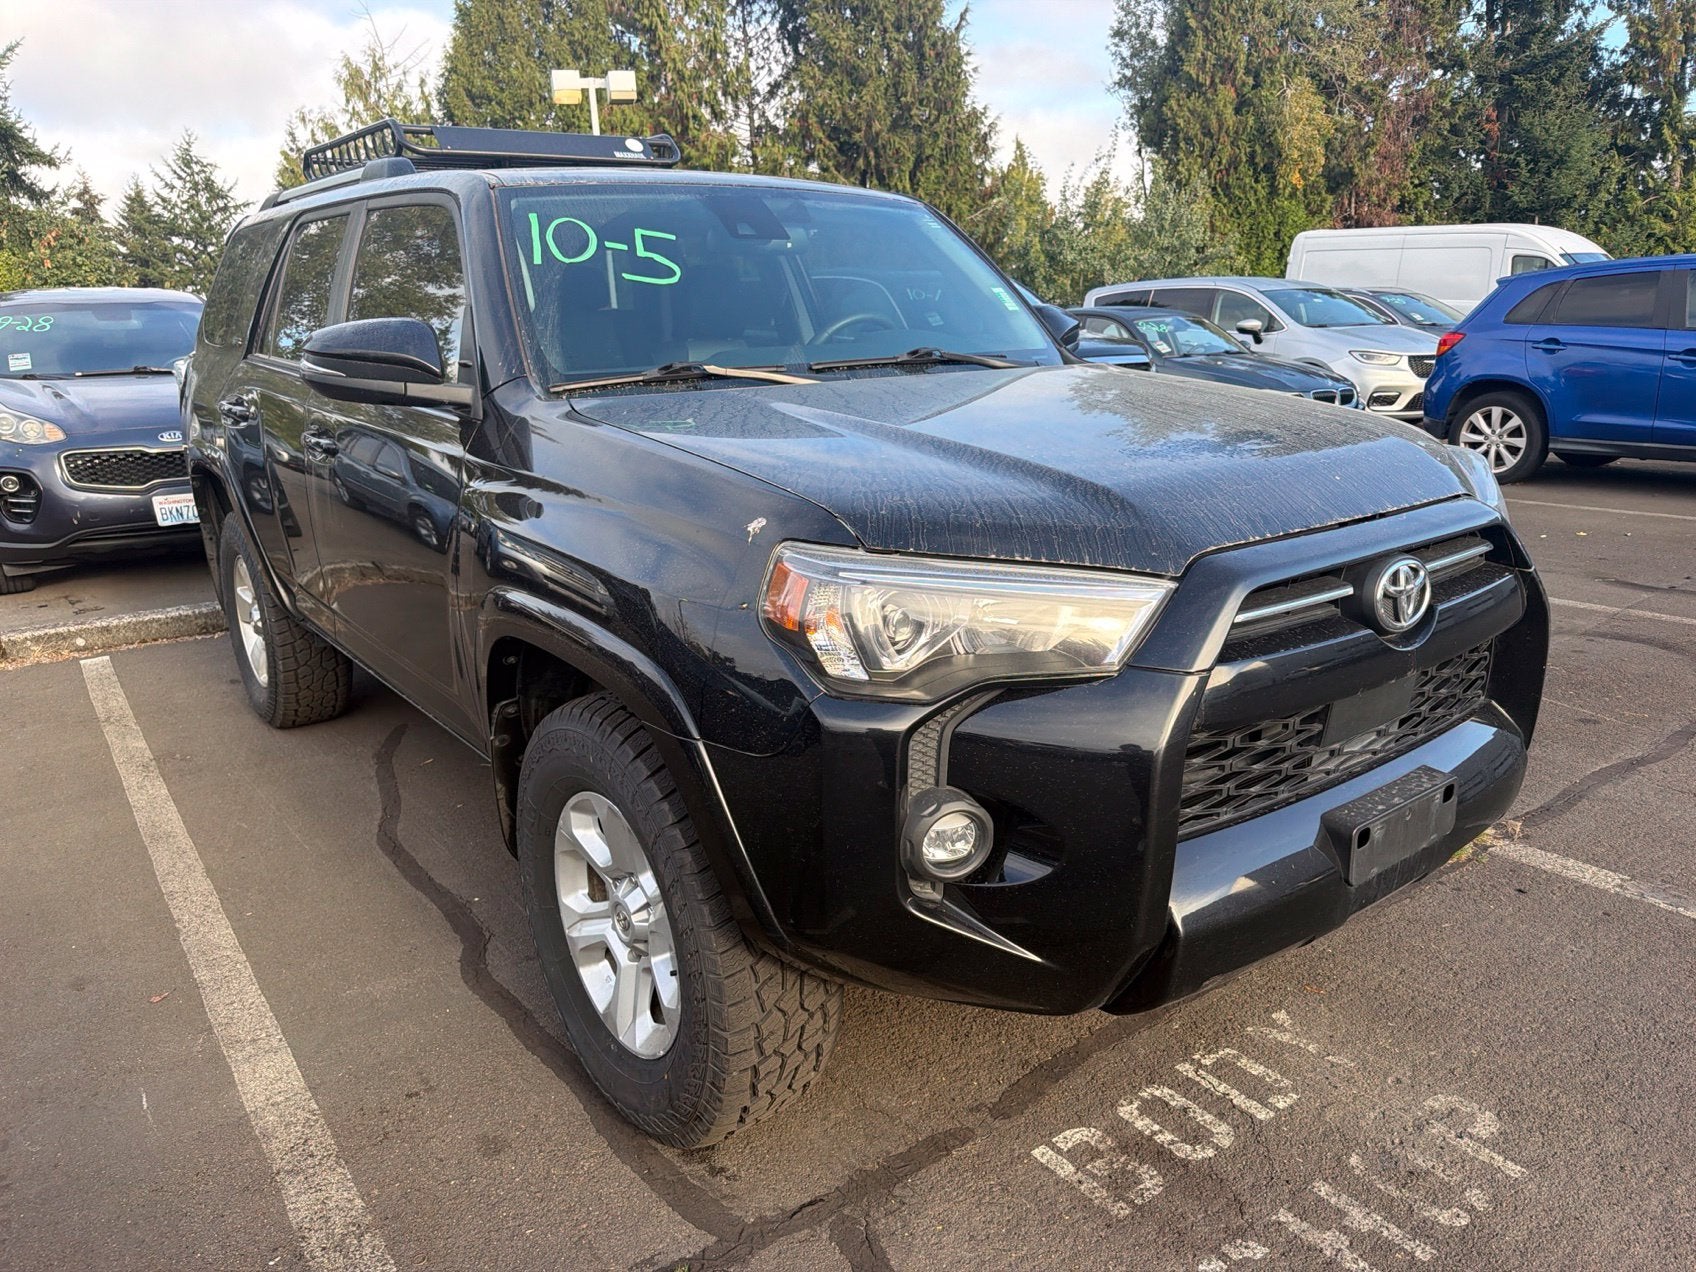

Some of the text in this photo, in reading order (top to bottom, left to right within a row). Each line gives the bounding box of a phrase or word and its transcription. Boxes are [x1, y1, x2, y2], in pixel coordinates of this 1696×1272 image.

[528, 212, 682, 285] 10-5
[0, 315, 54, 332] 9-28
[1031, 1009, 1357, 1219] BODY
